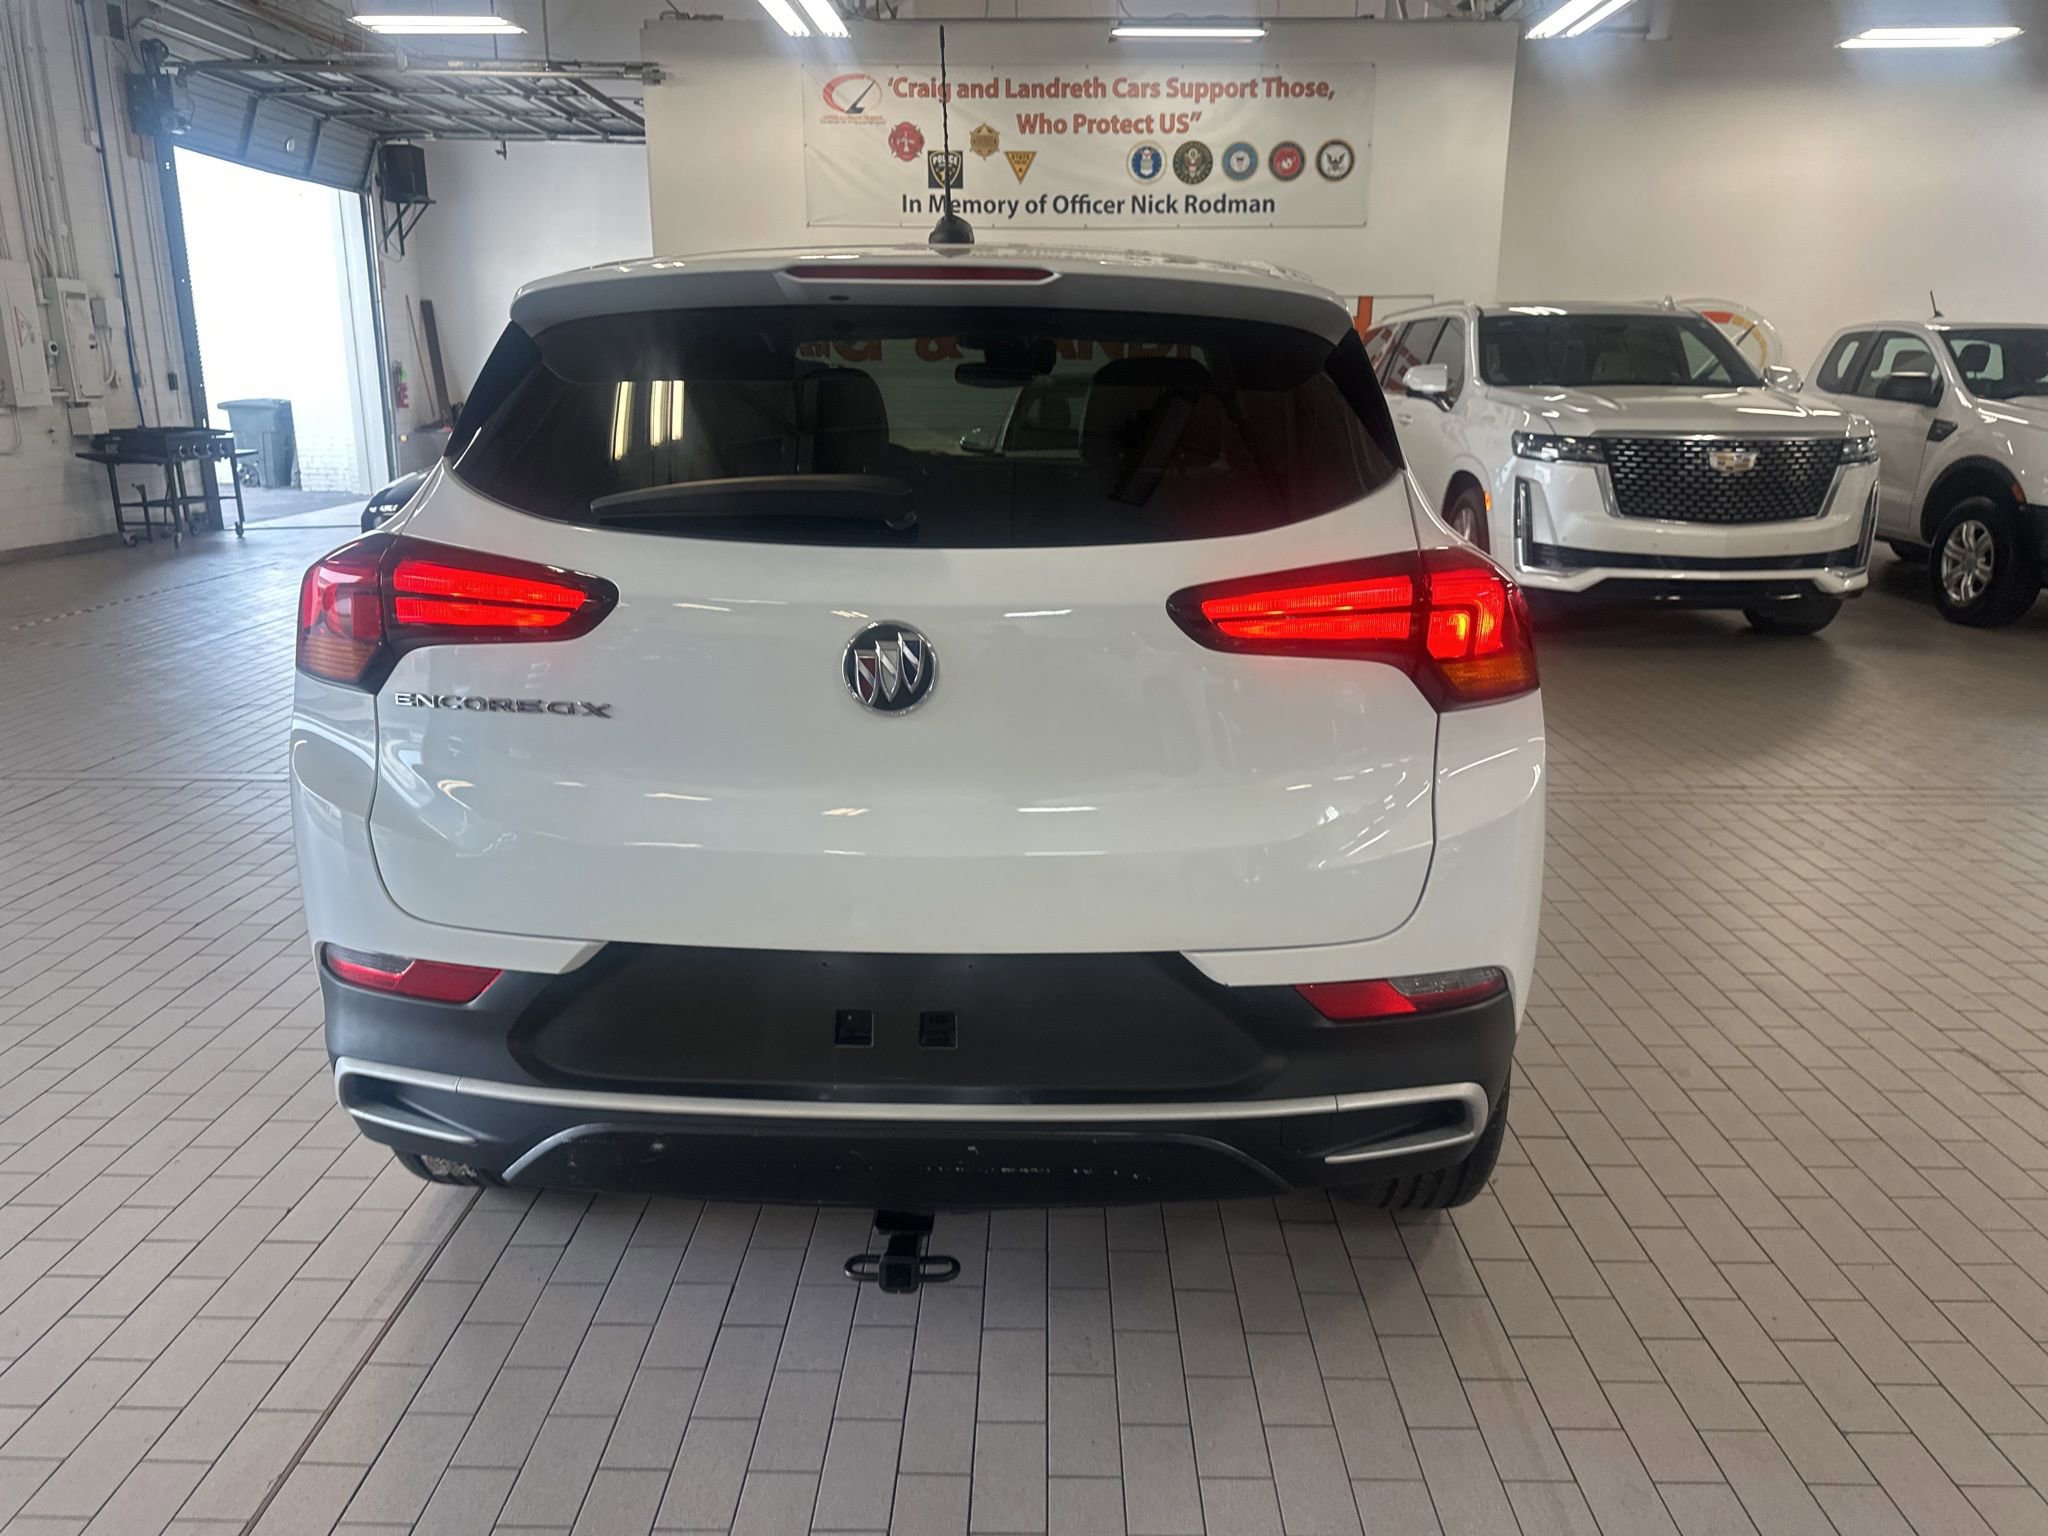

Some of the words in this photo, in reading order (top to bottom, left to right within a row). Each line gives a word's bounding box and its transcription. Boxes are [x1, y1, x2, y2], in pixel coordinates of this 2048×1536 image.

[957, 76, 999, 99] and
[1005, 77, 1107, 99] Landreth
[1112, 77, 1161, 98] Cars
[1166, 76, 1258, 103] Support
[1262, 75, 1335, 101] Those,
[1016, 112, 1067, 135] Who
[1072, 113, 1154, 135] Protect
[902, 194, 922, 213] In
[928, 194, 1019, 219] Memory
[1025, 194, 1047, 214] of
[1052, 193, 1125, 214] Officer
[1131, 194, 1178, 214] Nick
[1184, 193, 1275, 214] Rodman
